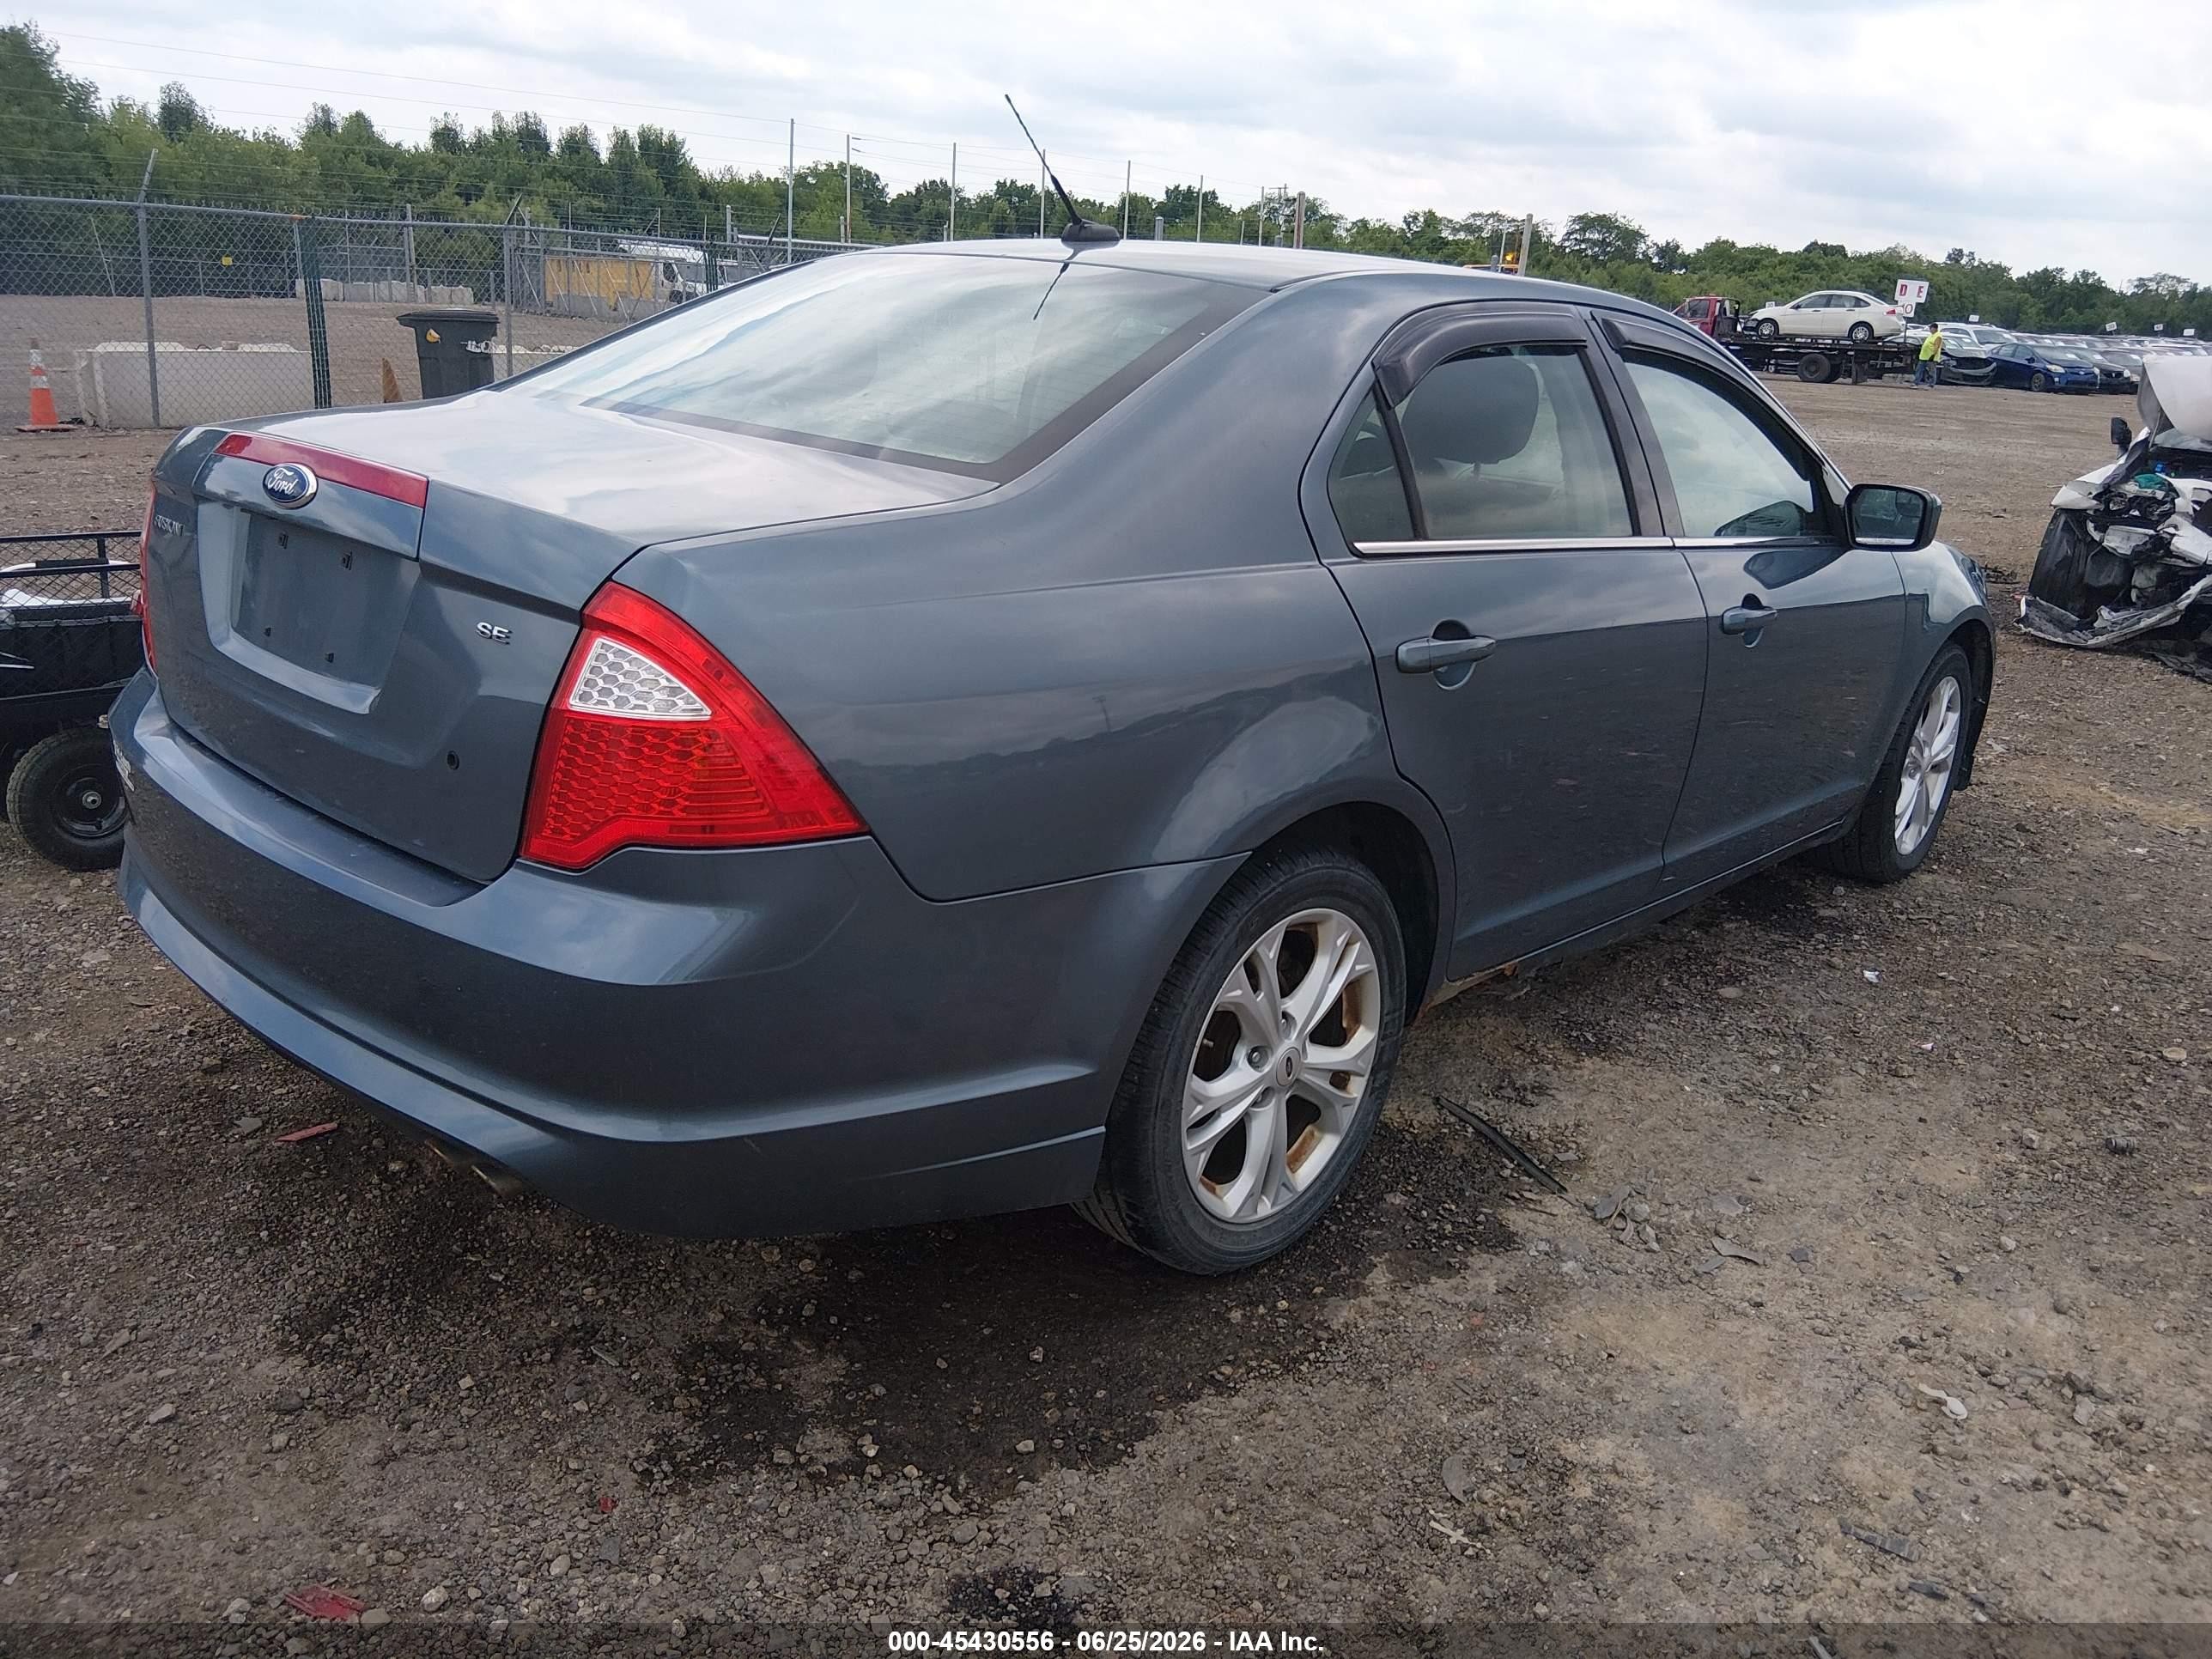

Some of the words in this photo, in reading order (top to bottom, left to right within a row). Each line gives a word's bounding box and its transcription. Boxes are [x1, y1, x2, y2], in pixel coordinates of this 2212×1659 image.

[1899, 284, 1908, 296] D
[1917, 286, 1924, 298] E
[267, 467, 299, 495] Ford
[476, 622, 511, 644] SE
